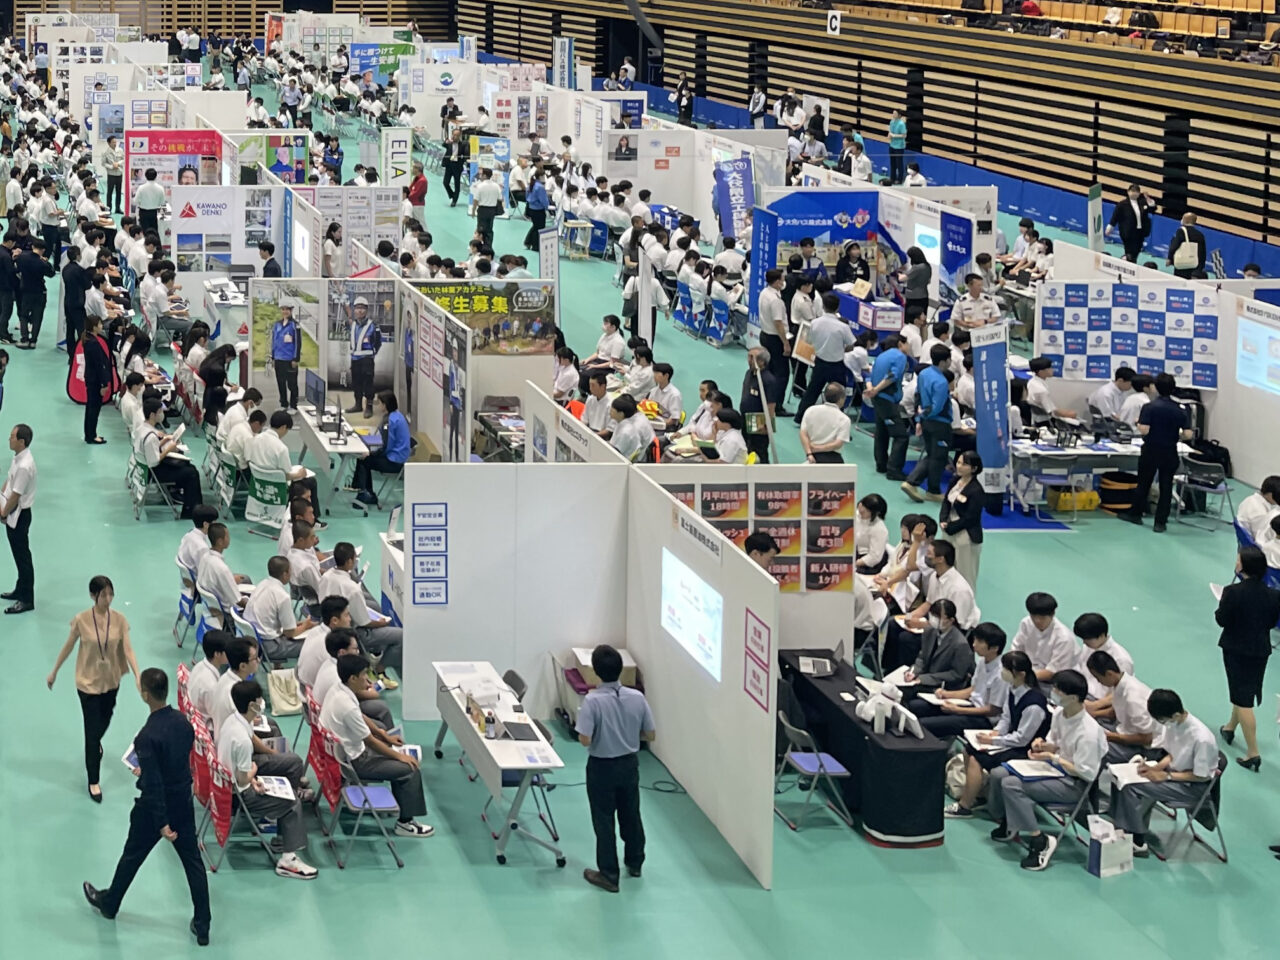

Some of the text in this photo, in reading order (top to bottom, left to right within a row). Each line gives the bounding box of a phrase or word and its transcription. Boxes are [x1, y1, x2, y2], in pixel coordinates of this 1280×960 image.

[829, 14, 838, 32] C
[391, 139, 408, 180] ELIA
[196, 201, 228, 211] KAWANO
[201, 208, 223, 217] DENKI
[808, 489, 854, 500] プライベート
[820, 525, 841, 536] 賞与
